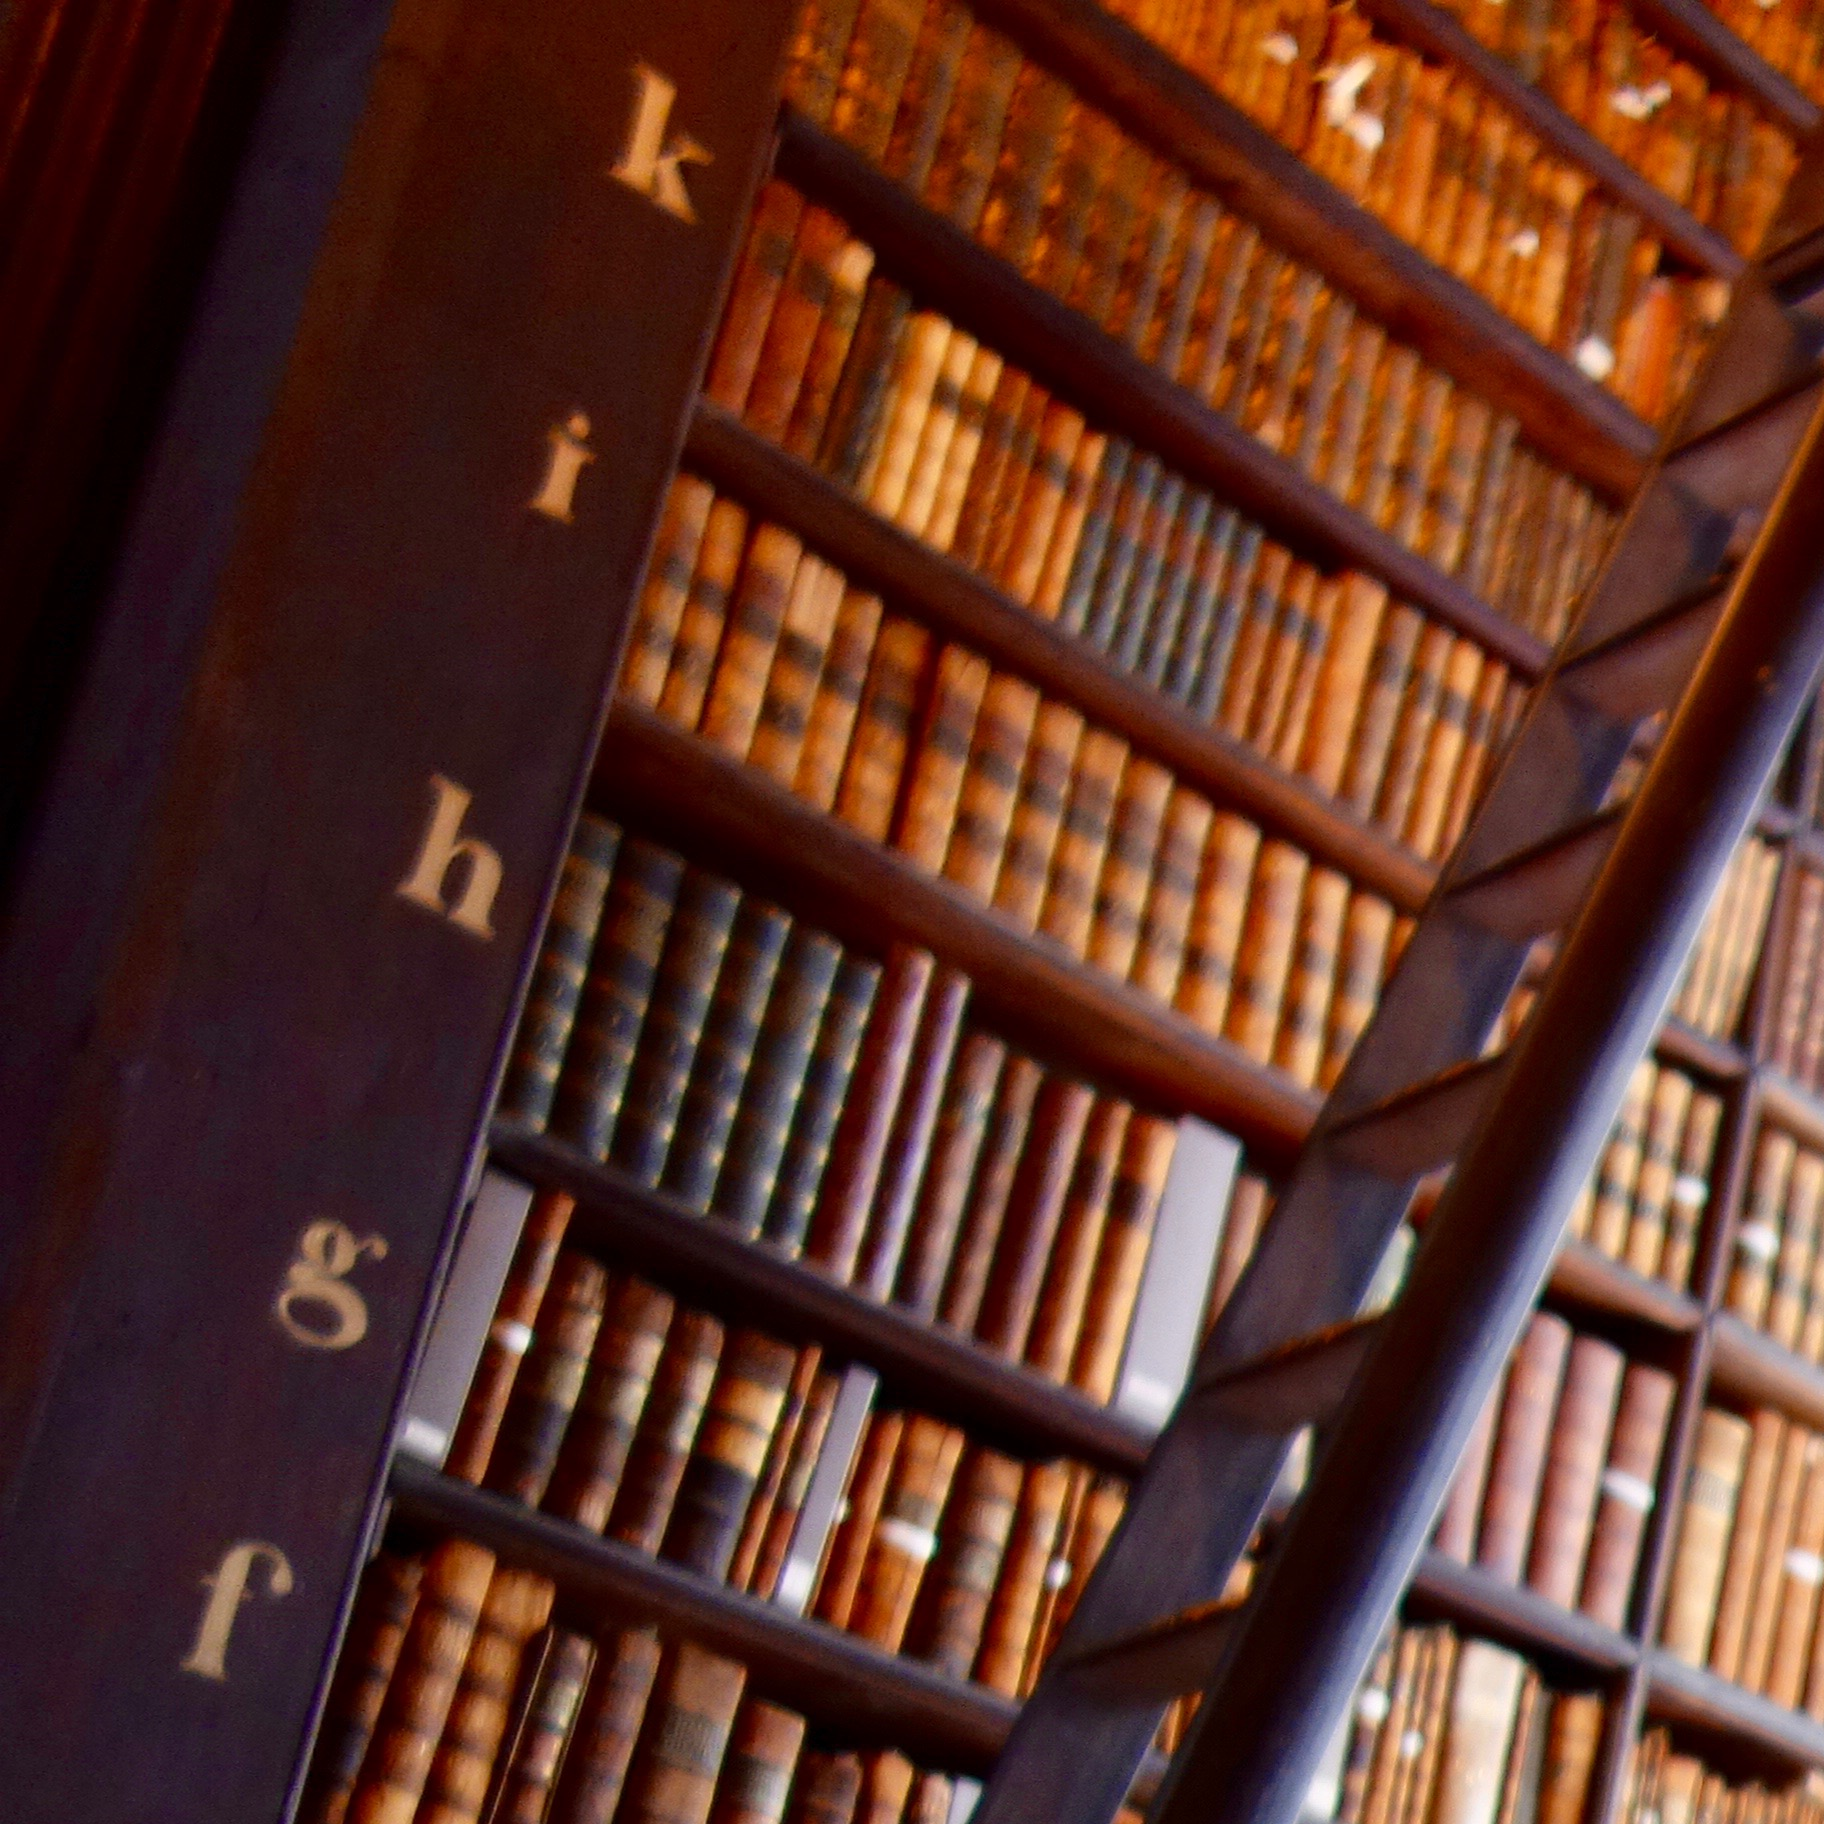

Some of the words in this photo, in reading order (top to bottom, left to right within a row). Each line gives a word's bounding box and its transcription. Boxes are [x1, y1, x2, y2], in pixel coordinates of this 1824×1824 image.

[608, 60, 712, 224] k
[529, 411, 594, 524] i
[398, 774, 504, 938] h
[275, 1219, 388, 1350] g
[180, 1541, 293, 1681] f
